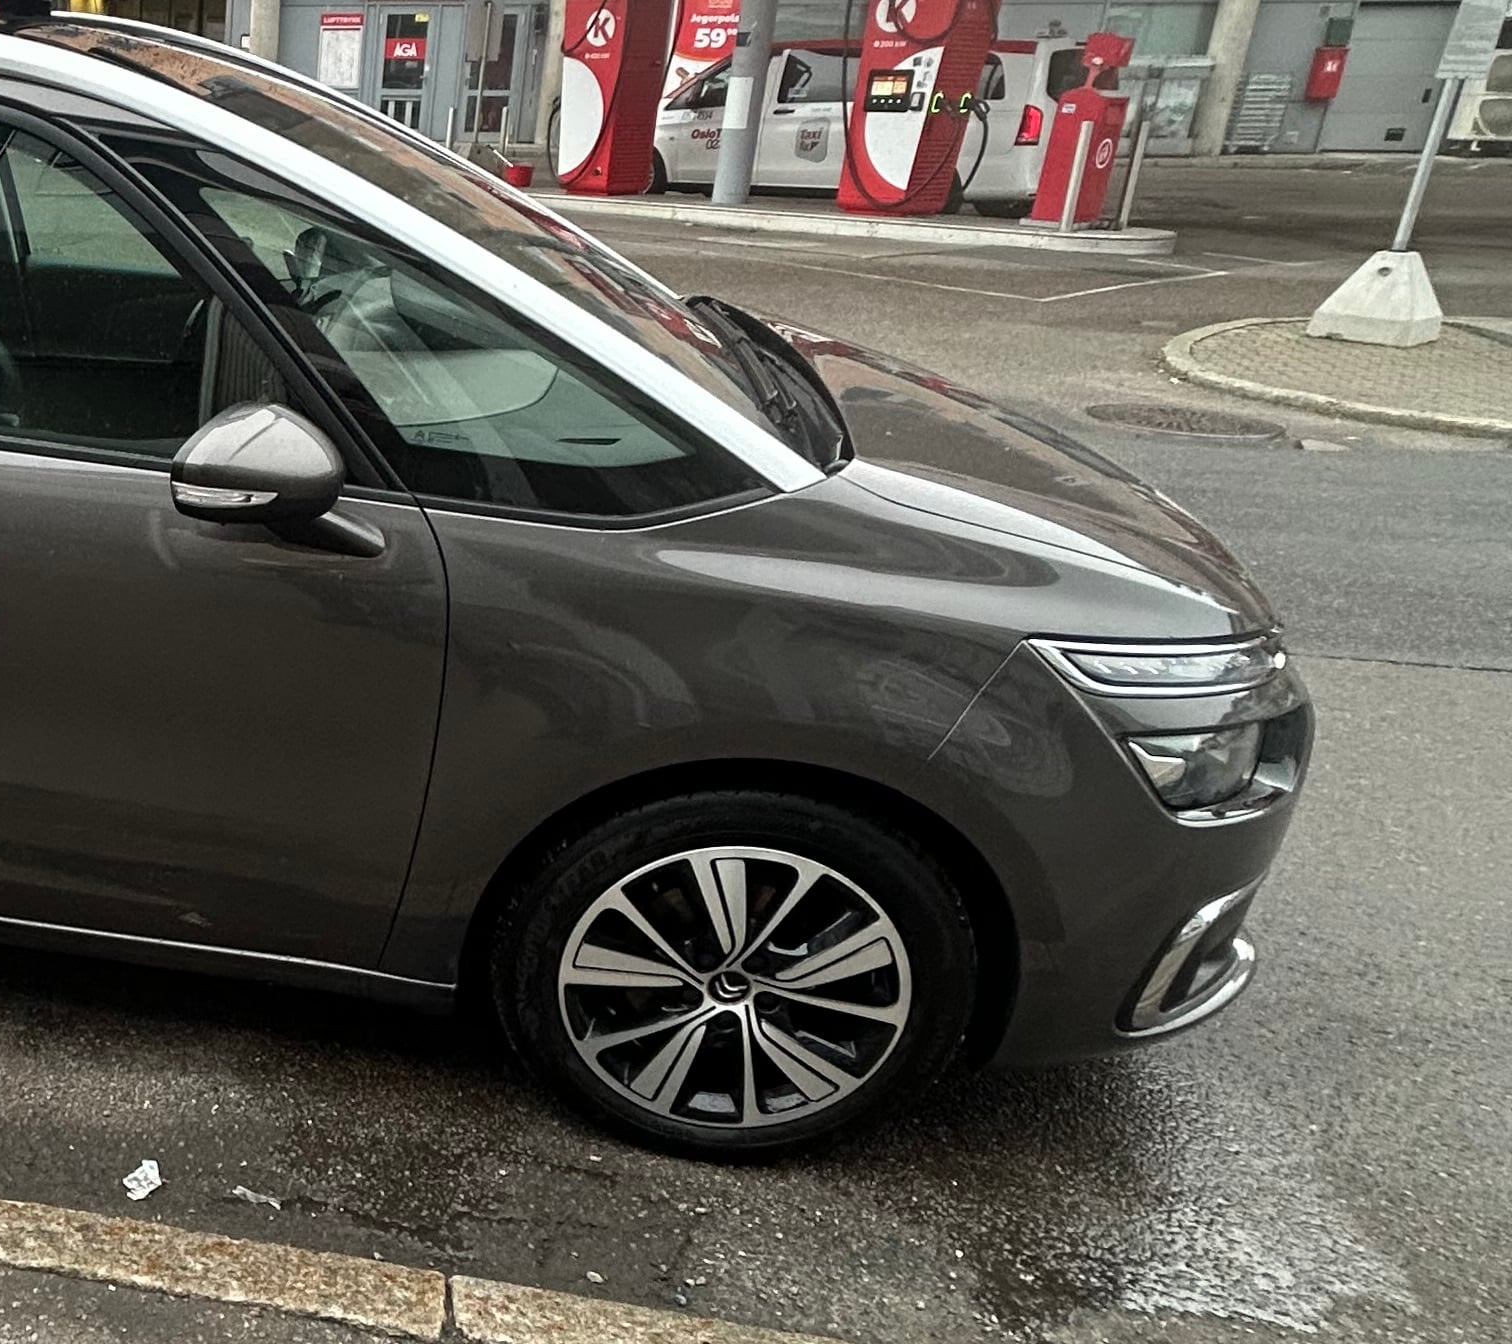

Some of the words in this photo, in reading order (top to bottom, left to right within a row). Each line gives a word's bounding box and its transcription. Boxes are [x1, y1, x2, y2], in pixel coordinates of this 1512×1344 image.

[693, 27, 727, 48] 59
[393, 42, 418, 56] AGA
[691, 128, 723, 140] OsloT
